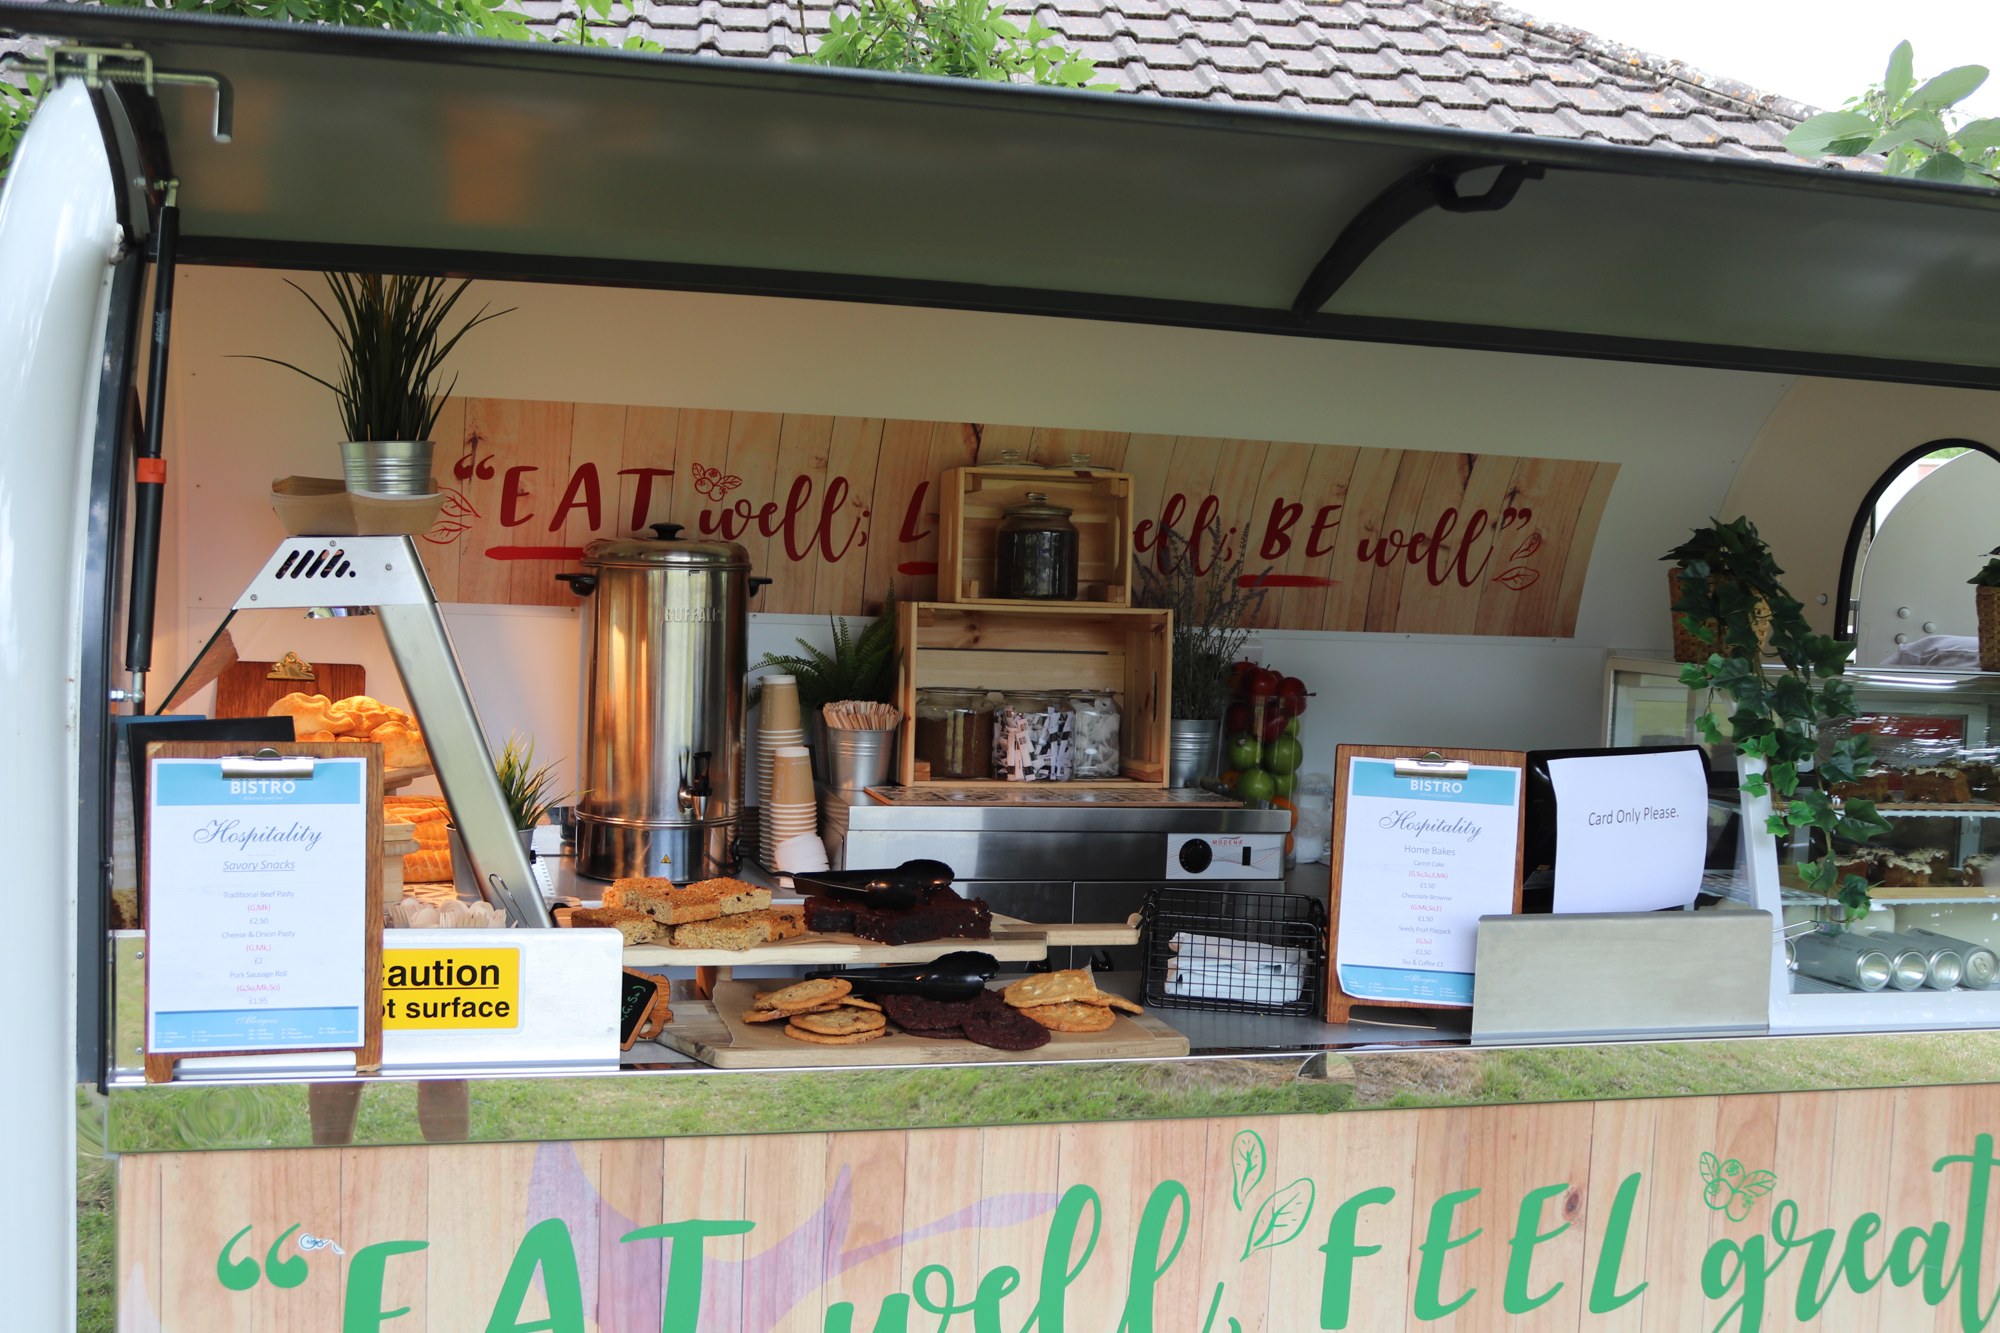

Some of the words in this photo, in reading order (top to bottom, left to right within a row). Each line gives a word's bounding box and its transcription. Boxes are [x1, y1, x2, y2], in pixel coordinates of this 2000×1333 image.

[1133, 492, 1236, 577] ell;
[1260, 497, 1342, 560] BE
[230, 780, 296, 795] BISTRO
[1410, 779, 1463, 794] BISTRO
[1588, 810, 1613, 826] Card
[1616, 807, 1641, 825] Only
[1643, 806, 1680, 821] Please.
[1378, 810, 1482, 843] Hospitality
[193, 818, 322, 852] Hospitality
[1404, 845, 1430, 855] Home
[1431, 846, 1456, 856] Bakes
[223, 859, 259, 872] Savory
[260, 859, 296, 871] Snacks
[223, 891, 259, 899] Traditional
[260, 890, 275, 898] Beef
[276, 890, 295, 899] Pasty
[1401, 892, 1429, 900] Chocolate
[249, 917, 269, 925] £2.50
[221, 931, 247, 939] Cheese
[255, 930, 277, 938] Onion
[277, 930, 296, 938] Pasty
[254, 957, 263, 965] £2
[1418, 959, 1436, 967] Coffee
[246, 971, 274, 979] Sausage
[383, 959, 500, 987] aution
[405, 996, 511, 1018] surface
[825, 1180, 1243, 1333] well
[1318, 1171, 1649, 1331] FEEL
[1700, 1132, 2000, 1333] great
